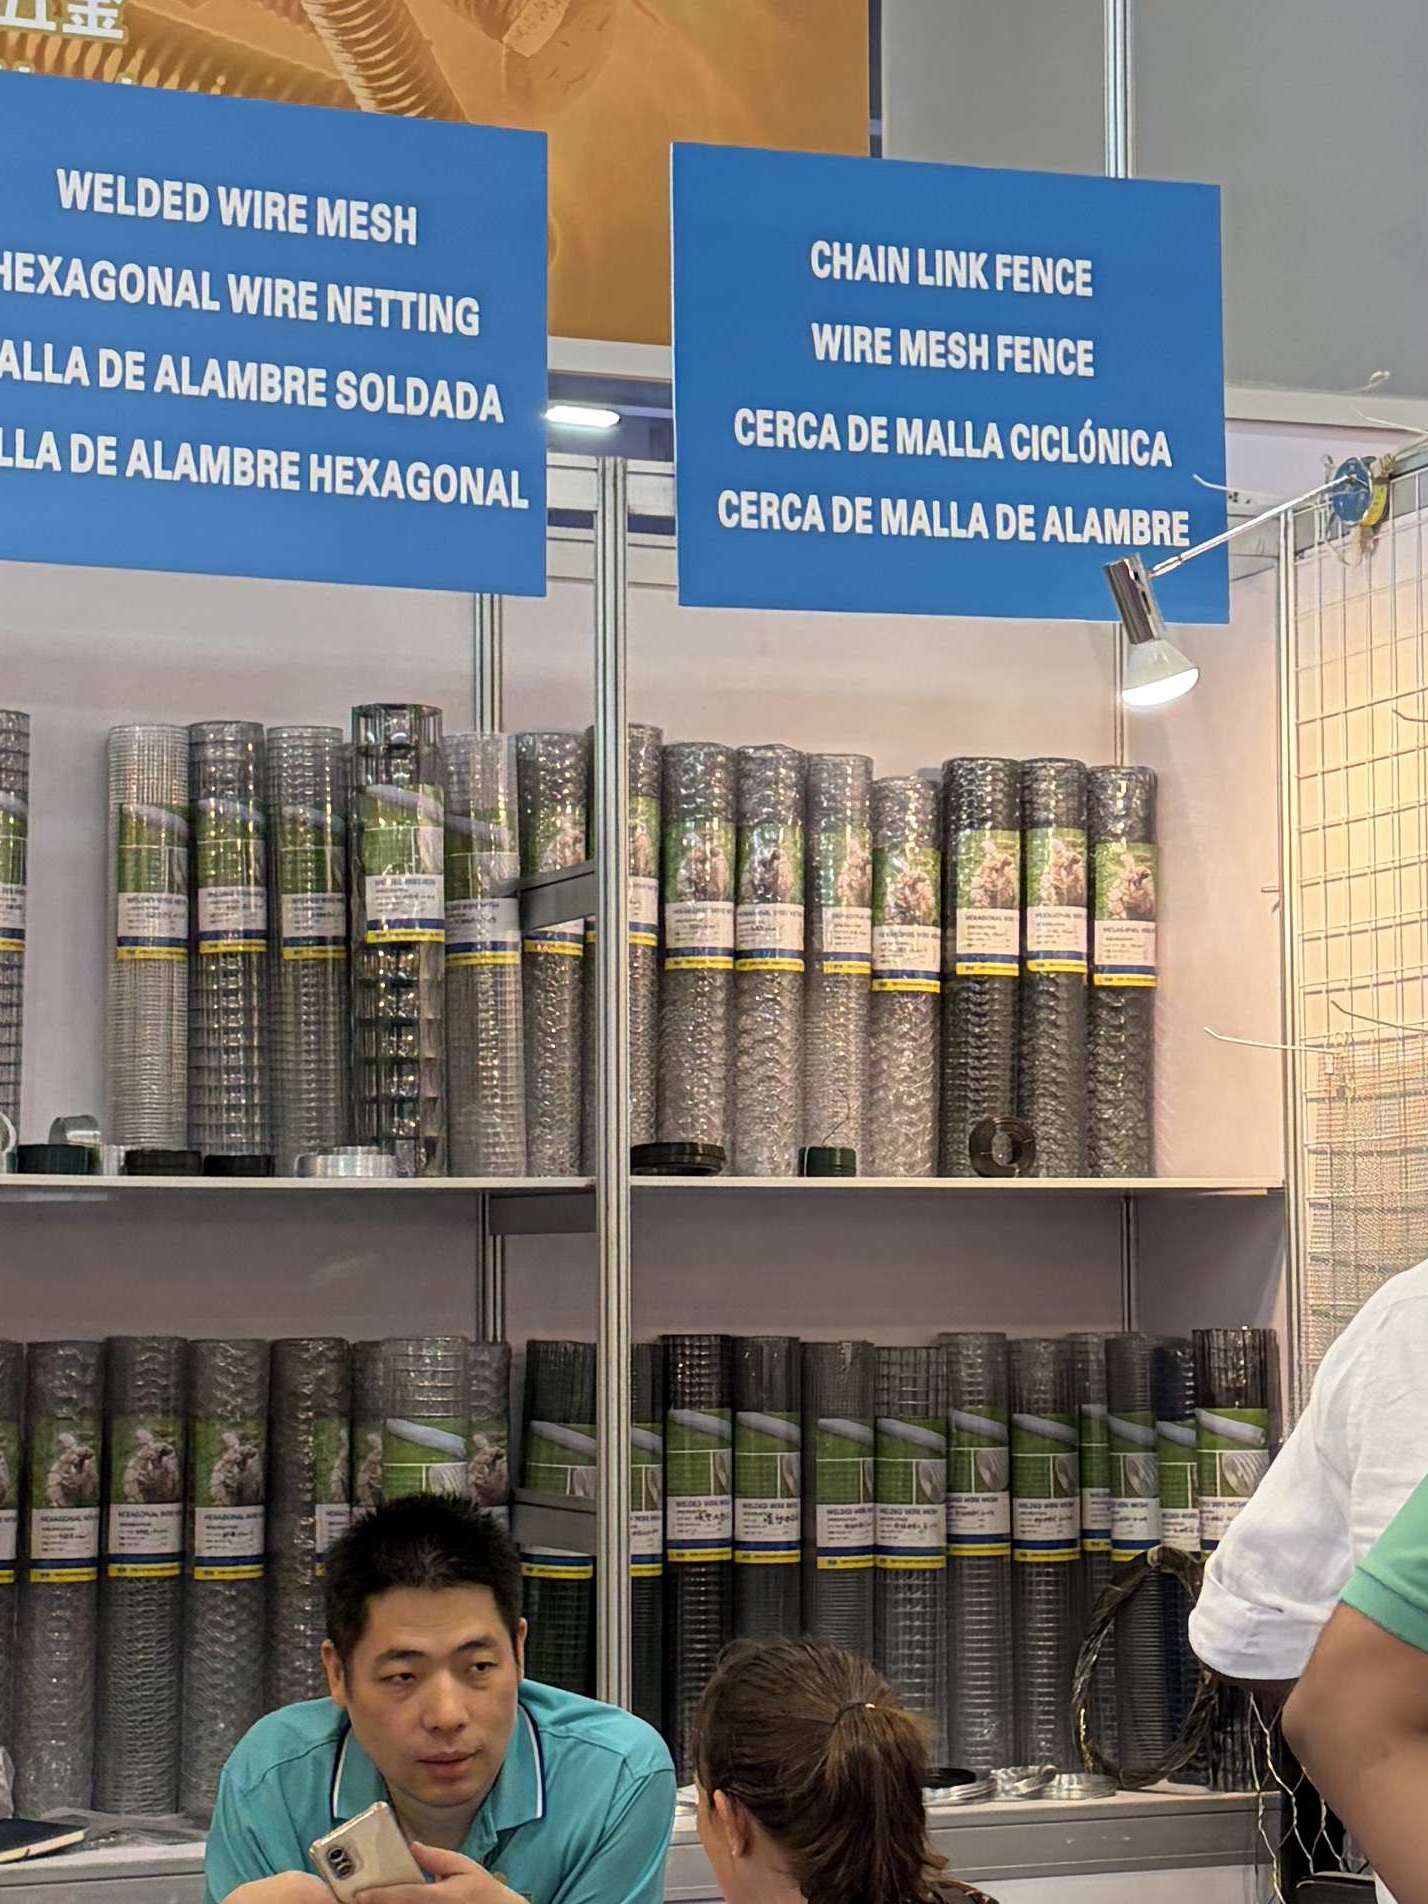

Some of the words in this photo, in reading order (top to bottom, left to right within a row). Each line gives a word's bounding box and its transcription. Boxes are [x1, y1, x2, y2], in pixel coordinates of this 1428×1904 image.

[56, 167, 209, 223] WELDED
[217, 186, 308, 234] WIRE
[316, 198, 418, 245] MESH
[810, 240, 910, 285] CHAIN
[918, 248, 989, 291] LINK
[995, 253, 1093, 297] FENCE
[227, 272, 318, 320] WIRE
[327, 284, 480, 336] NETTING
[811, 323, 892, 366] WIRE
[899, 329, 989, 372] MESH
[996, 335, 1095, 377] FENCE
[98, 347, 146, 391] DE
[153, 354, 328, 408] ALAMBRE
[334, 371, 504, 424] SOLDADA
[734, 407, 841, 453] CERCA
[848, 415, 888, 454] DE
[896, 417, 1004, 460] MALLA
[1010, 418, 1173, 468] CICLÓNICA
[70, 434, 117, 477] DE
[125, 439, 300, 491] ALAMBRE
[309, 454, 529, 510] HEXAGONAL
[718, 489, 825, 533] CERCA
[832, 495, 873, 535] DE
[881, 498, 989, 541] MALLA
[995, 503, 1036, 542] DE
[1042, 505, 1189, 547] ALAMBRE
